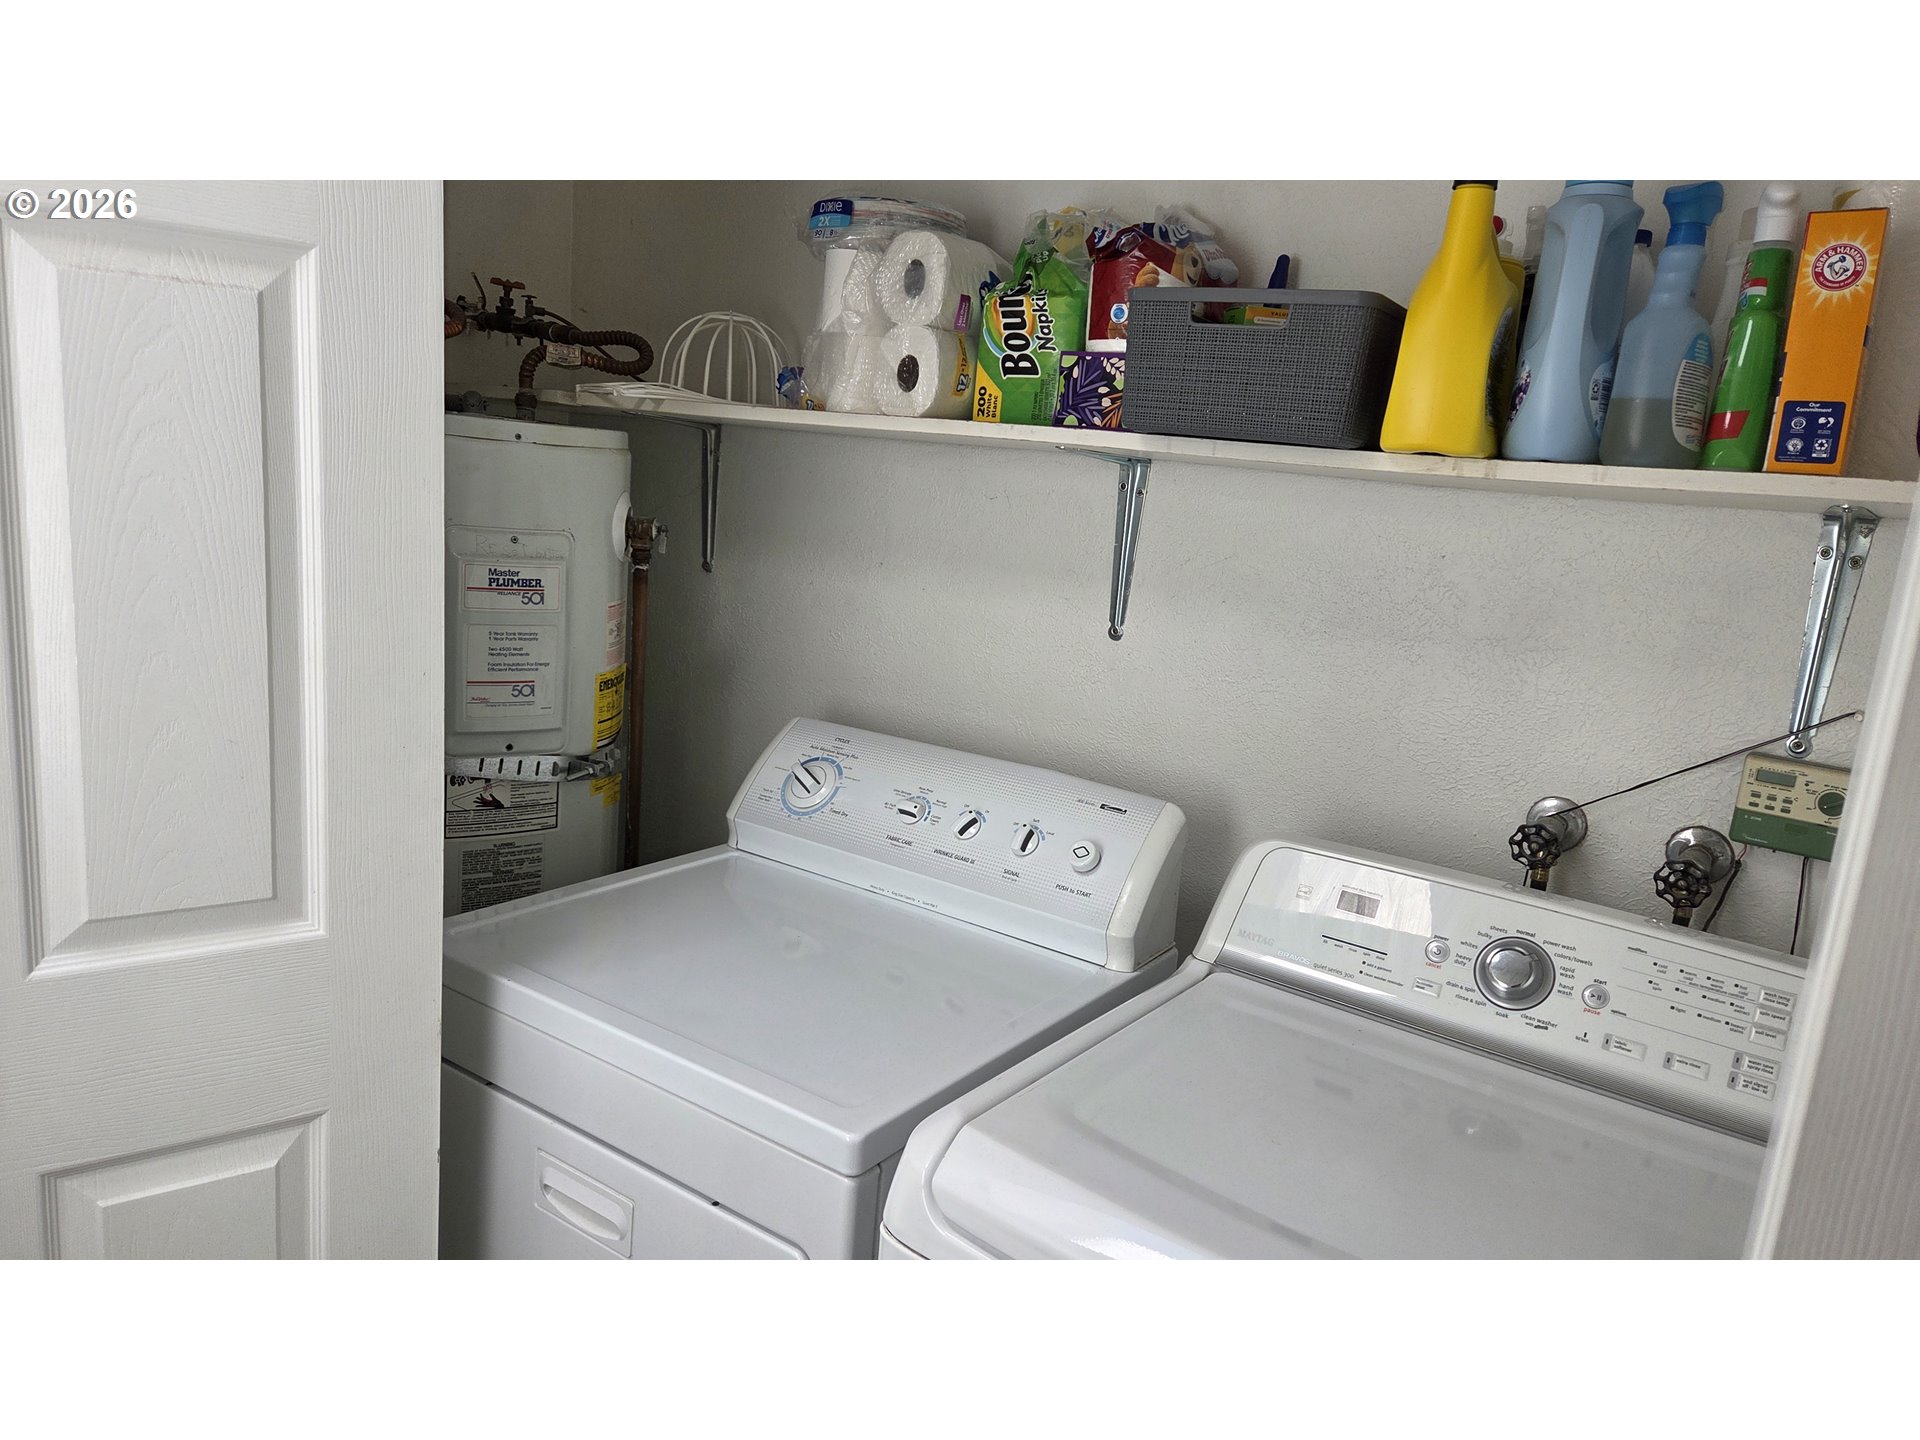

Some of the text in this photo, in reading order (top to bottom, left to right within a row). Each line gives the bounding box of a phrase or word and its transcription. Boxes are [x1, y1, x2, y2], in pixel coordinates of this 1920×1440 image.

[817, 216, 831, 227] 2X
[1815, 254, 1829, 272] ARM
[1836, 246, 1864, 272] HAMMER
[1000, 271, 1041, 378] Boun
[977, 386, 987, 417] 200
[488, 568, 520, 577] Master
[488, 577, 544, 588] PLUMBER
[521, 592, 545, 605] 501
[511, 684, 535, 697] 501
[953, 854, 970, 863] GUARD
[1003, 868, 1020, 878] SIGNAL
[1055, 883, 1069, 892] PUSH
[1075, 889, 1092, 898] START
[1490, 925, 1508, 934] sheets
[1515, 928, 1536, 939] normal
[1237, 929, 1275, 948] MAYTAG
[1433, 934, 1449, 942] power
[1477, 930, 1493, 940] bulky
[1460, 940, 1478, 949] whites
[1542, 940, 1577, 952] power wash
[1277, 950, 1311, 966] BRAVOS
[1455, 953, 1472, 962] heavy
[1554, 952, 1593, 967] colors/towels
[1425, 961, 1441, 969] cancel
[1454, 959, 1467, 967] duty
[1312, 962, 1355, 979] quiet series 300
[1559, 966, 1576, 974] rapid
[1559, 972, 1576, 980] wash
[1445, 980, 1460, 988] drain
[1558, 982, 1574, 991] hand
[1593, 978, 1608, 986] start
[1557, 989, 1573, 997] wash
[1455, 993, 1470, 1002] rinse
[1474, 999, 1487, 1008] spin
[1495, 1010, 1509, 1019] soak
[1583, 1007, 1601, 1016] pause
[1520, 1012, 1558, 1029] clean washer
